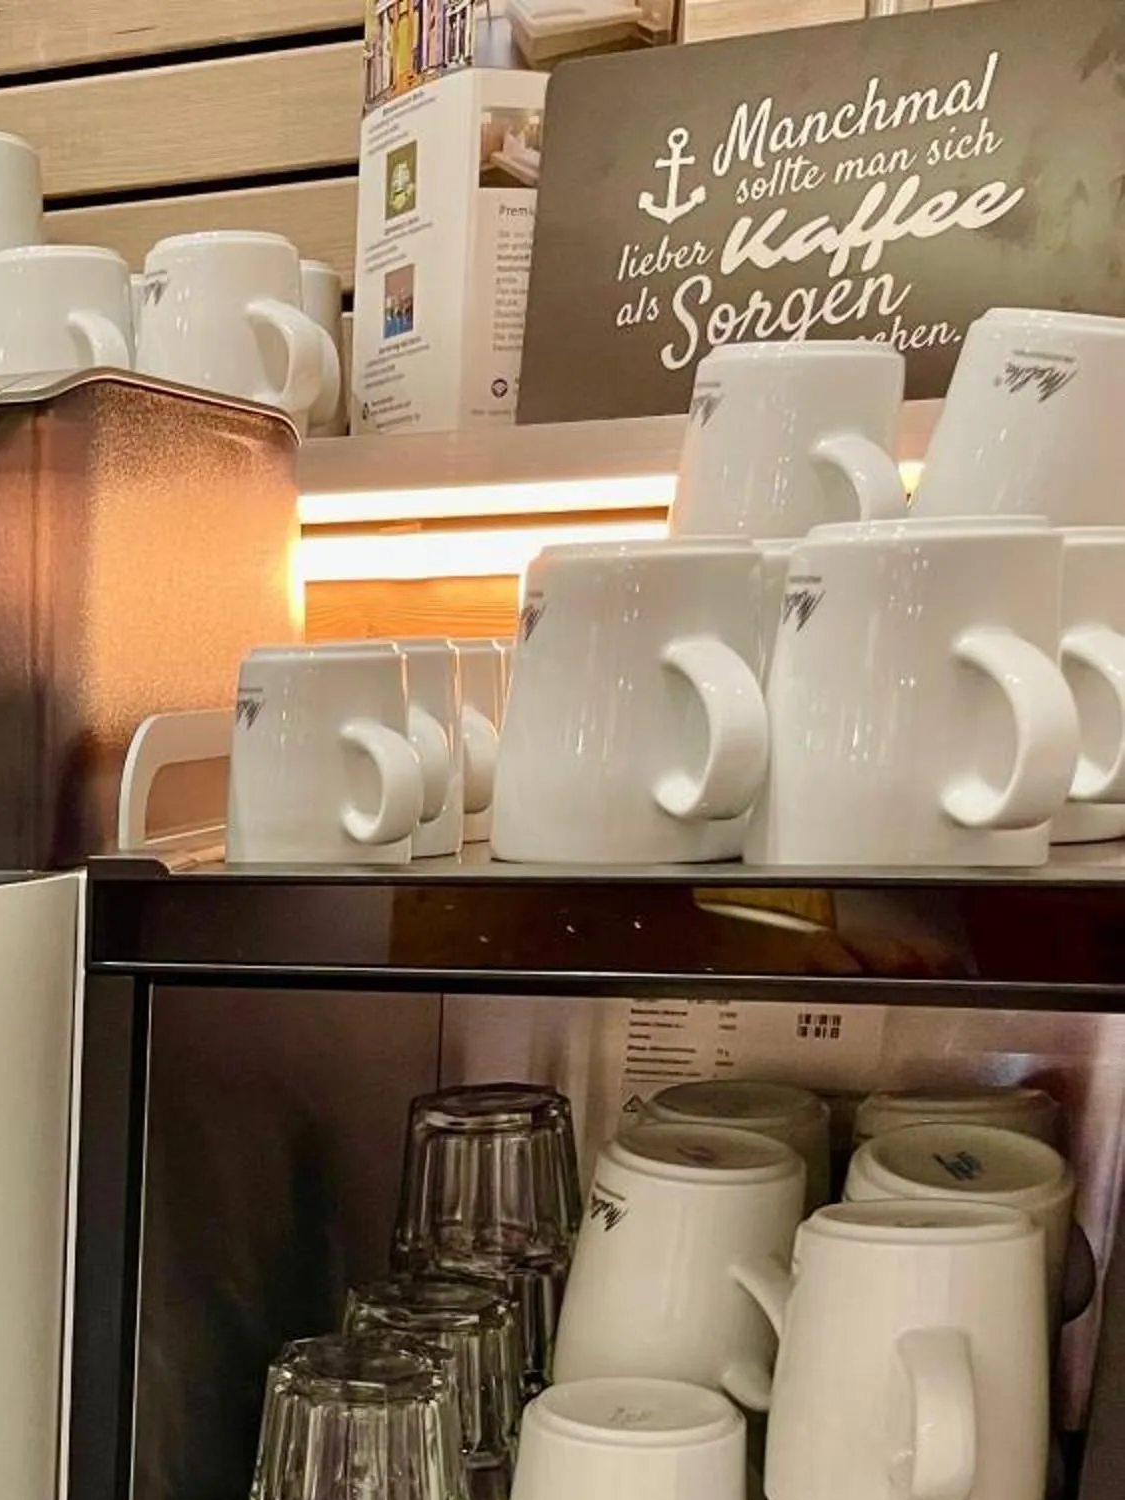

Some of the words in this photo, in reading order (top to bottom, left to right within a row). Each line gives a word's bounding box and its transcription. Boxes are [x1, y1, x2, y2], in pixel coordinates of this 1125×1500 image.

[712, 50, 1000, 178] Manchmal
[735, 156, 825, 205] sollte
[833, 150, 917, 184] man
[926, 117, 1004, 167] sich
[617, 241, 714, 281] lieber
[719, 175, 1024, 276] Kaffee
[616, 287, 660, 327] als
[660, 272, 912, 371] Sorgen
